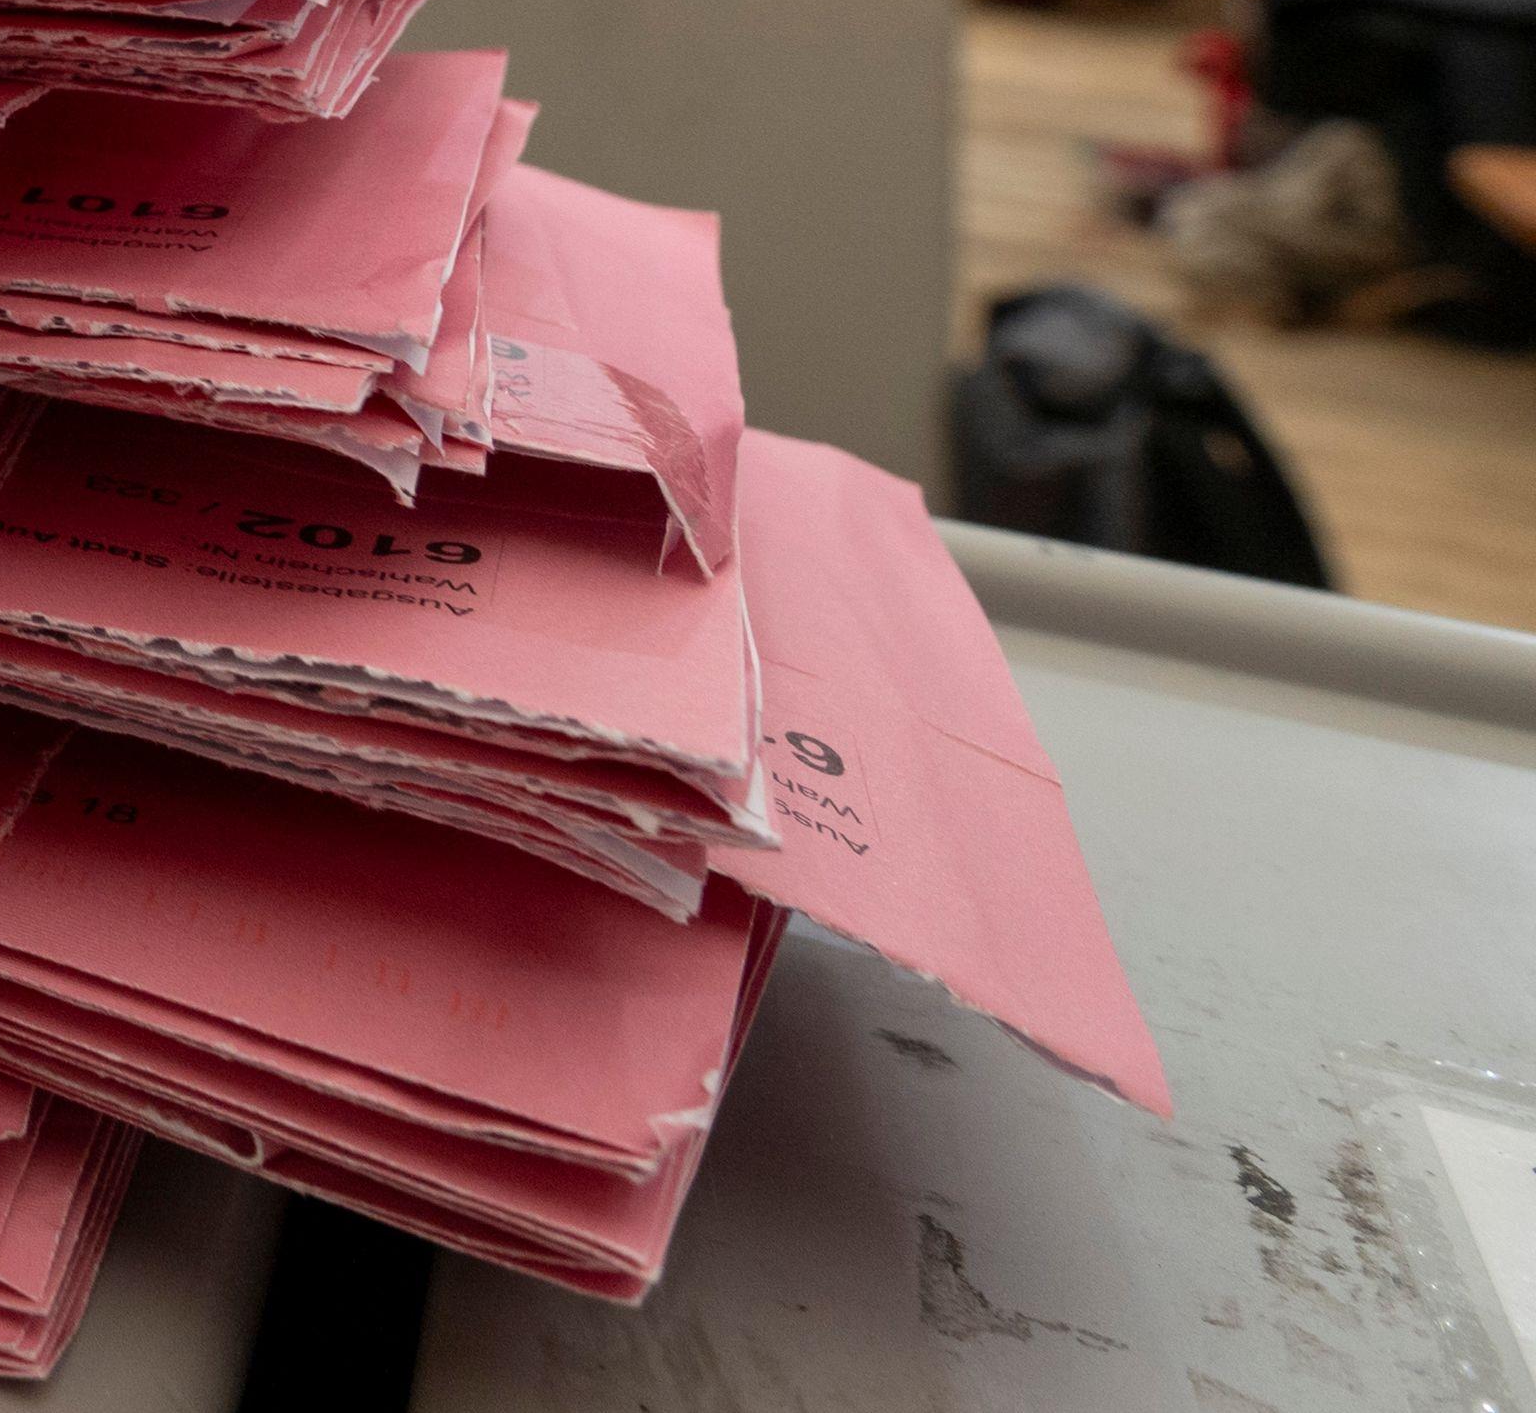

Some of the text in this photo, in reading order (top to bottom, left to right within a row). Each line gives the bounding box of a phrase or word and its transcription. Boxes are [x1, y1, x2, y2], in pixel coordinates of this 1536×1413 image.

[20, 185, 231, 221] 6101
[68, 535, 170, 569] Stadt
[236, 507, 482, 565] 6102
[252, 552, 477, 596] Wahlschein
[760, 730, 847, 778] 6
